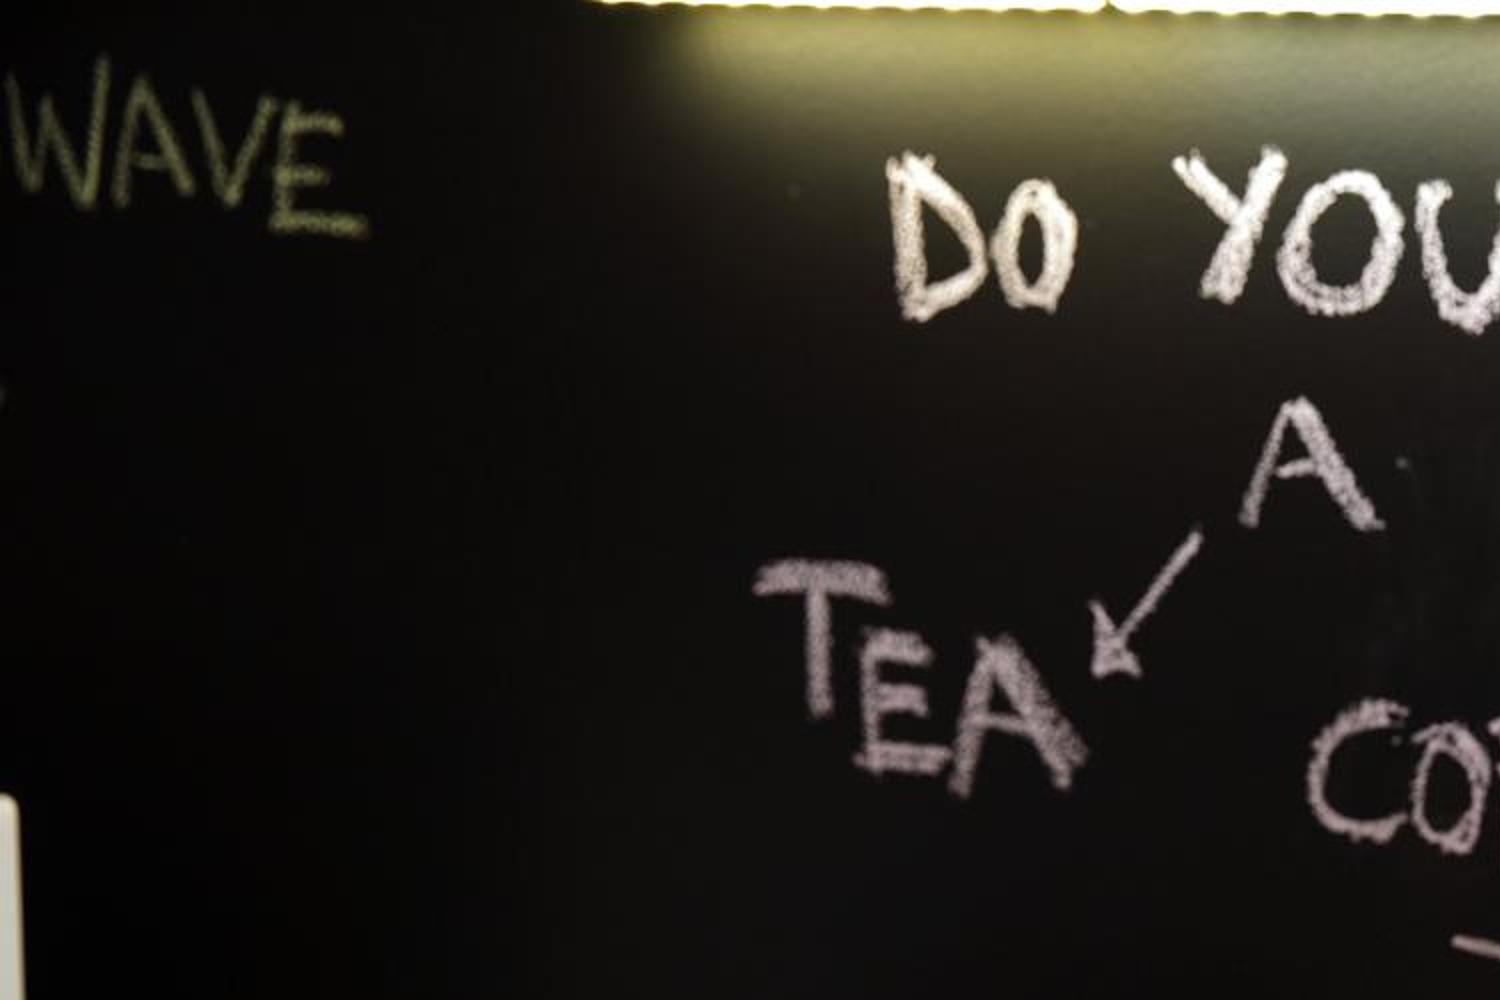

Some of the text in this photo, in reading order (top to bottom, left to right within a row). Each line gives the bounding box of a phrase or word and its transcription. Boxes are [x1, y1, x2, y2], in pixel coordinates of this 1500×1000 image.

[5, 56, 370, 238] WAVE
[885, 150, 1079, 322] DO
[1240, 396, 1385, 530] A
[753, 558, 1090, 799] TEA
